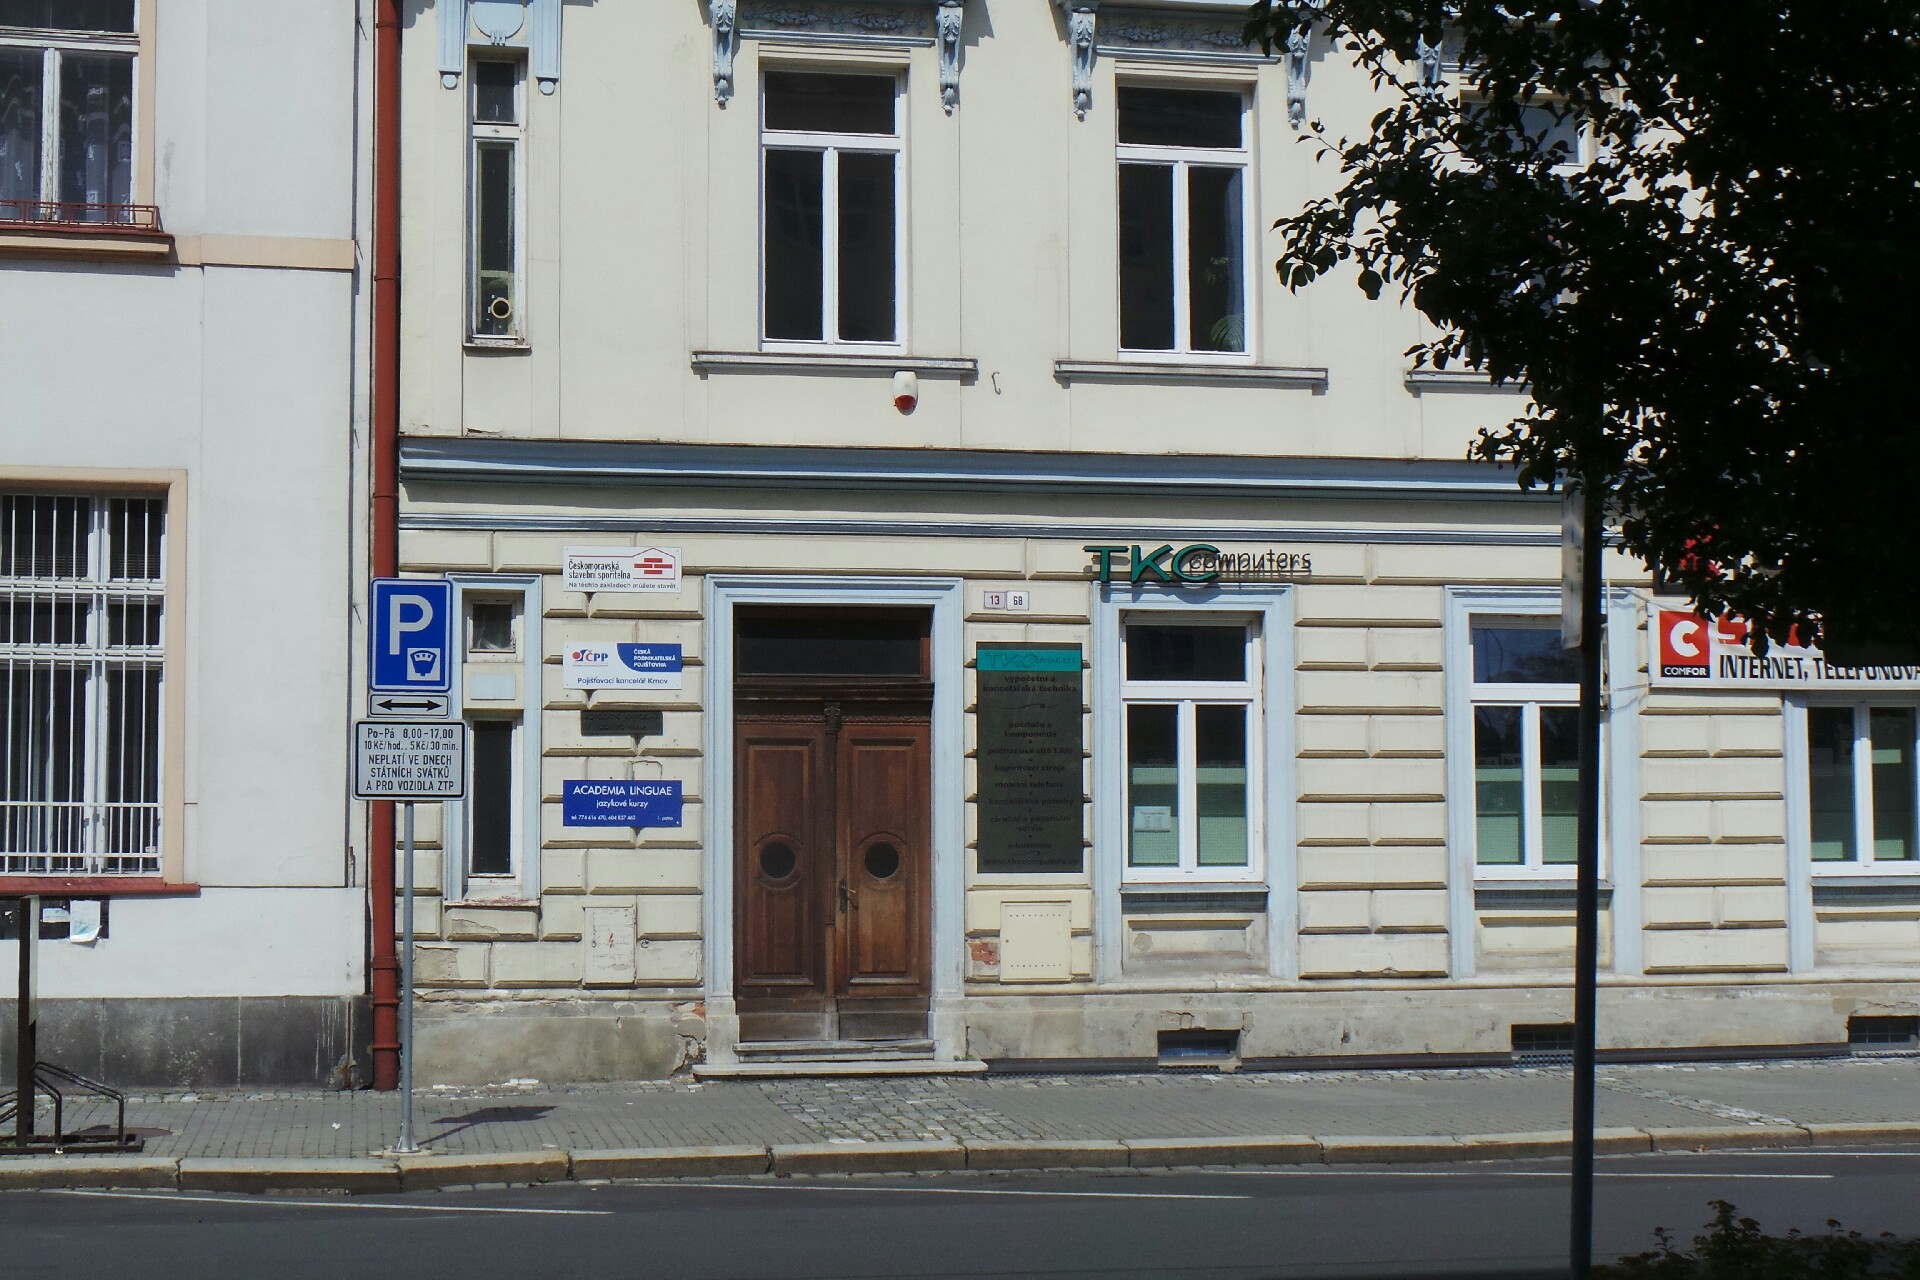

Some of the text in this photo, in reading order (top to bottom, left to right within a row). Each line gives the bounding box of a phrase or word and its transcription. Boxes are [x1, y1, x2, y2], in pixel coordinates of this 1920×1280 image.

[568, 558, 620, 572] Českomoravská
[1083, 544, 1312, 584] TKC computers
[568, 569, 631, 581] stavební spořitelna
[990, 595, 1000, 605] 13
[1013, 595, 1023, 606] 68
[389, 595, 434, 656] P
[1664, 666, 1708, 677] COMFOR
[1720, 654, 1808, 682] INTERNET,
[577, 676, 668, 686] Pojišťovací kancelář Krnov
[367, 727, 395, 739] Po-Pá
[364, 740, 372, 751] 10
[441, 740, 459, 751] min.
[368, 753, 452, 766] NEPLATÍ VE DNECH
[370, 765, 450, 779] STÁTNÍCH SVÁTKŮ
[366, 780, 455, 792] A PRO VOZIDLA ZTP
[572, 785, 673, 796] ACADEMIA LINGUAE
[596, 799, 649, 809] jazykové kurzy
